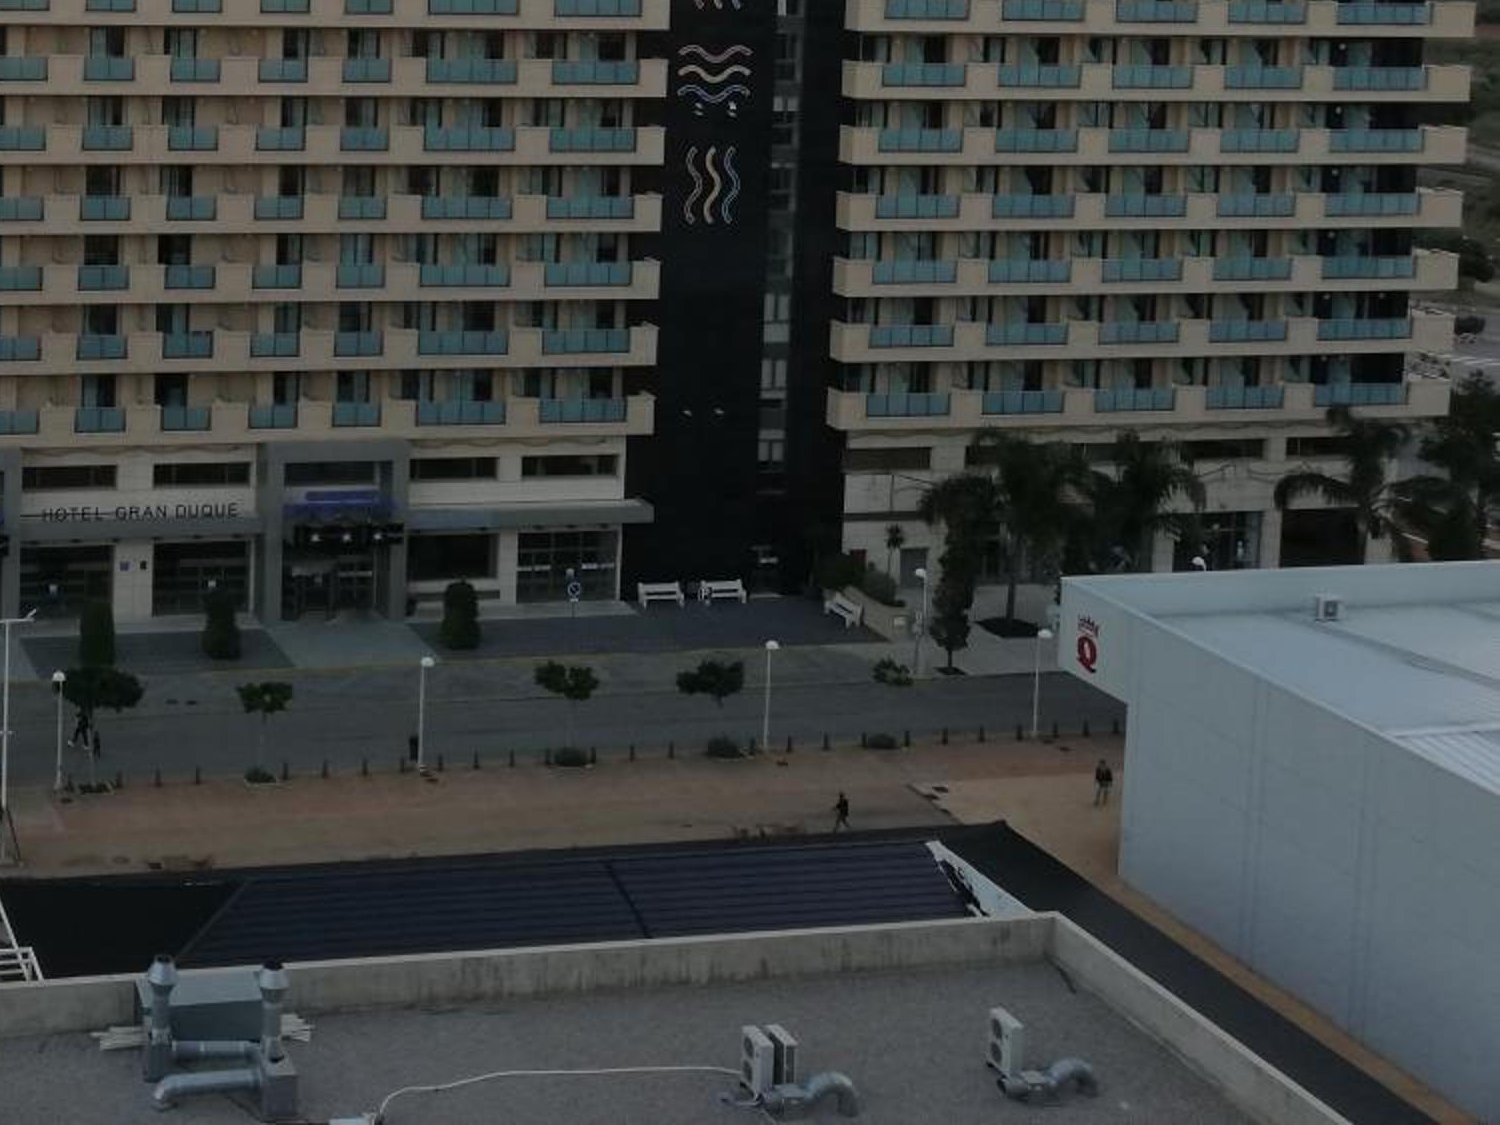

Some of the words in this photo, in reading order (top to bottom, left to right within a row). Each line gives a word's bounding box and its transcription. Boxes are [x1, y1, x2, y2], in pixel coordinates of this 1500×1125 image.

[41, 506, 104, 523] HOTEL
[114, 504, 168, 522] GRAN
[175, 502, 240, 520] DUQUE
